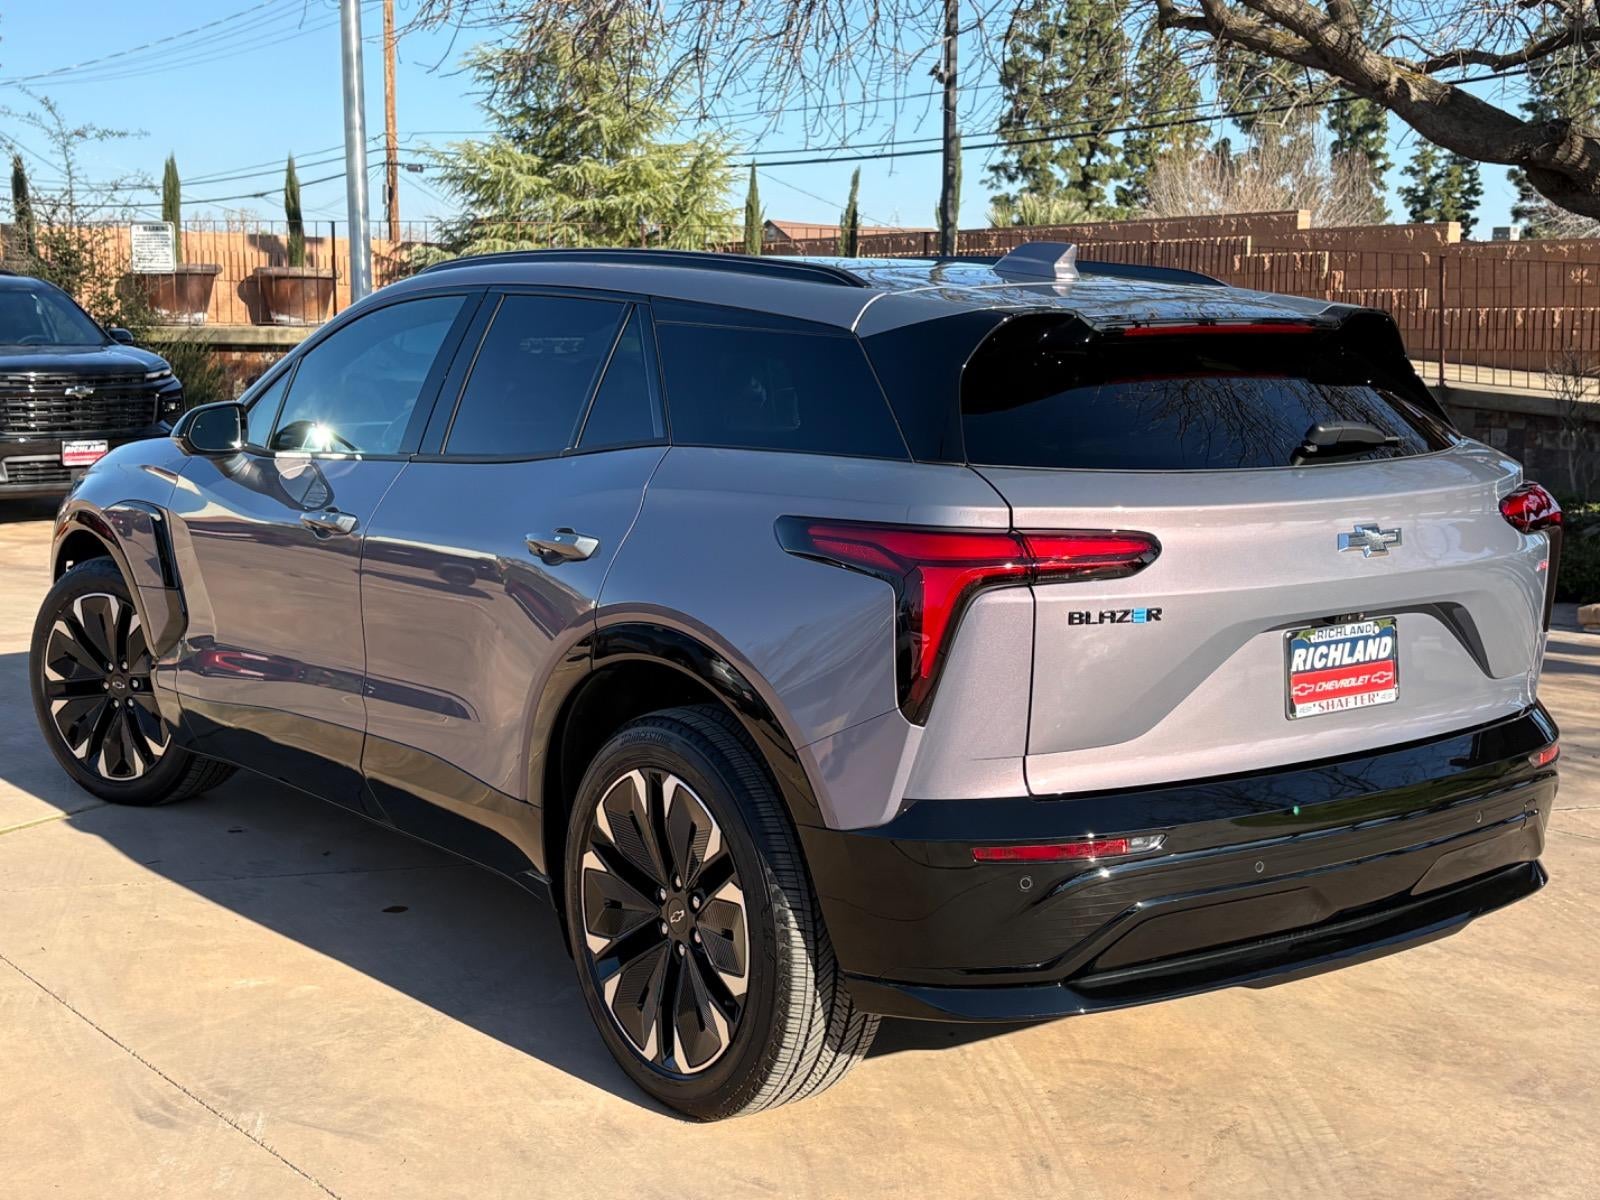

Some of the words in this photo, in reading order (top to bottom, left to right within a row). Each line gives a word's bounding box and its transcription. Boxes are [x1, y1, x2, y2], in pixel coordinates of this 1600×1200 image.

[1068, 607, 1162, 625] BLAZER
[1316, 623, 1372, 640] RICHLAND
[1291, 636, 1393, 672] RICHLAND
[1315, 675, 1371, 692] CHEVROLET
